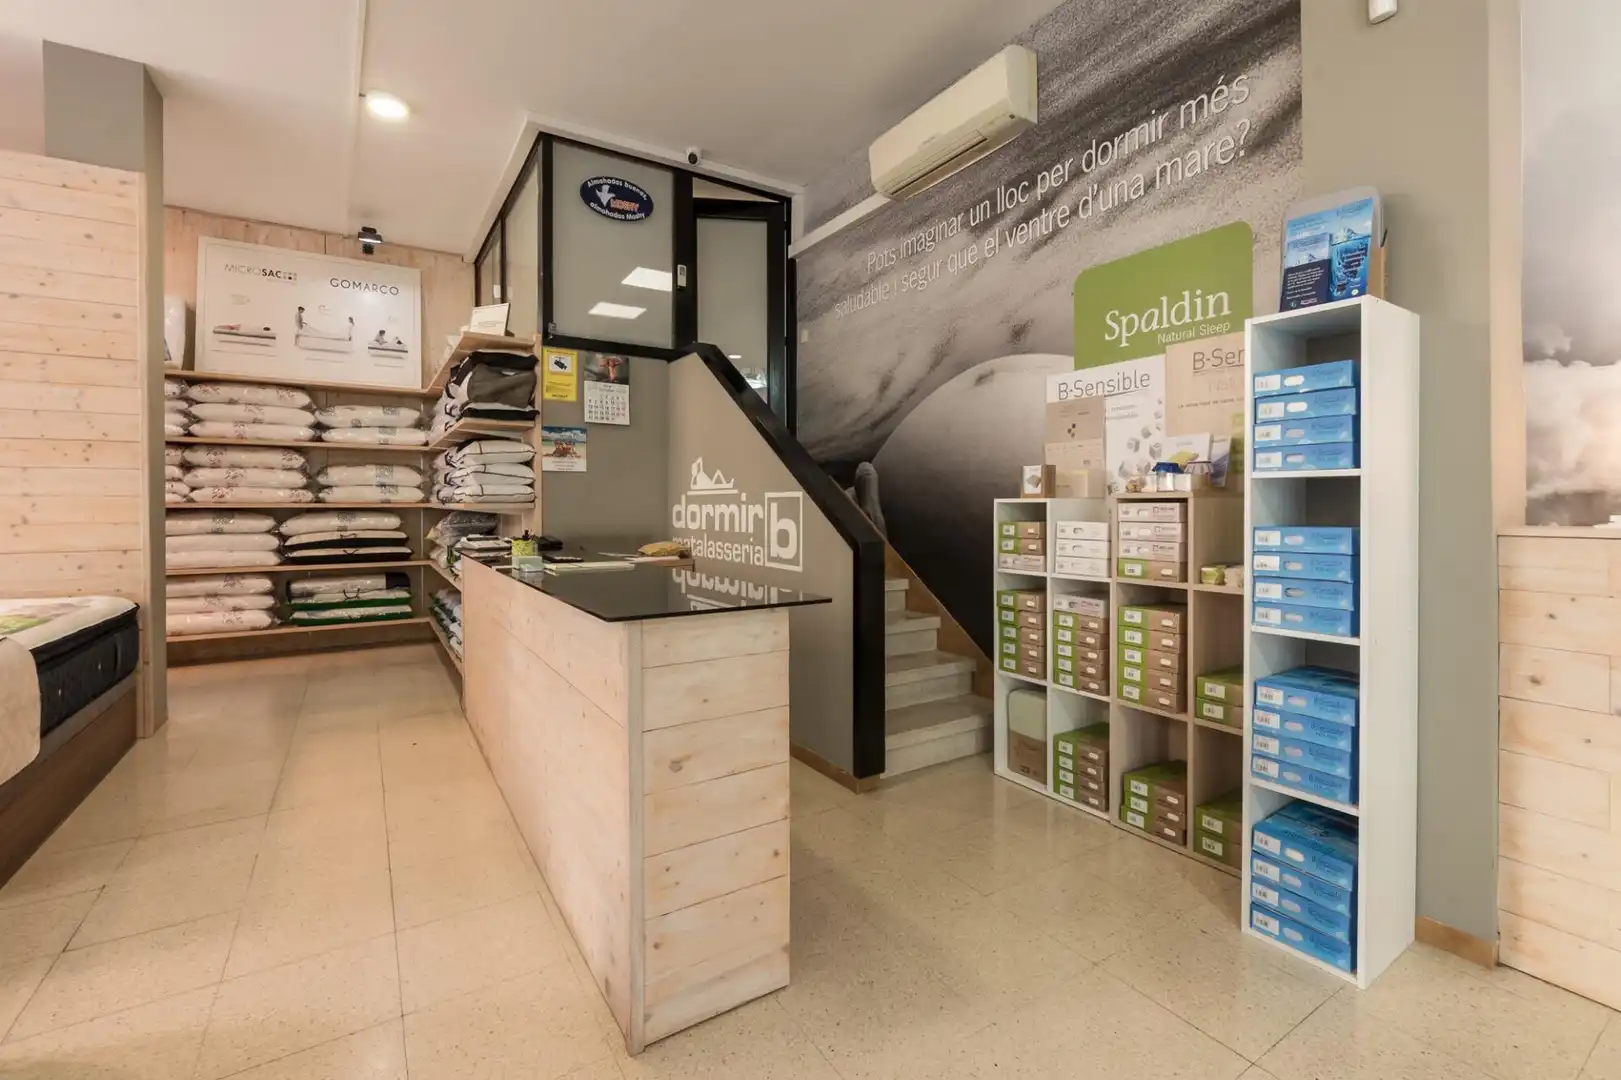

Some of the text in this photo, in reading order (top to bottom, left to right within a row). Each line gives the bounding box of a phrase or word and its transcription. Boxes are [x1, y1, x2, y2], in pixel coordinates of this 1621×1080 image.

[866, 74, 1250, 274] Pots imaginar un lloc per dormir més
[834, 281, 890, 319] saludable
[901, 259, 943, 291] segur
[947, 243, 978, 276] que
[984, 233, 999, 258] el
[1005, 203, 1070, 249] ventre
[1156, 118, 1251, 190] mare?
[224, 263, 282, 279] MICROSAC
[330, 277, 399, 296] GOMARCO
[1104, 289, 1232, 348] Spaldin
[1157, 321, 1231, 345] Natural Sleep
[672, 492, 764, 533] dormir
